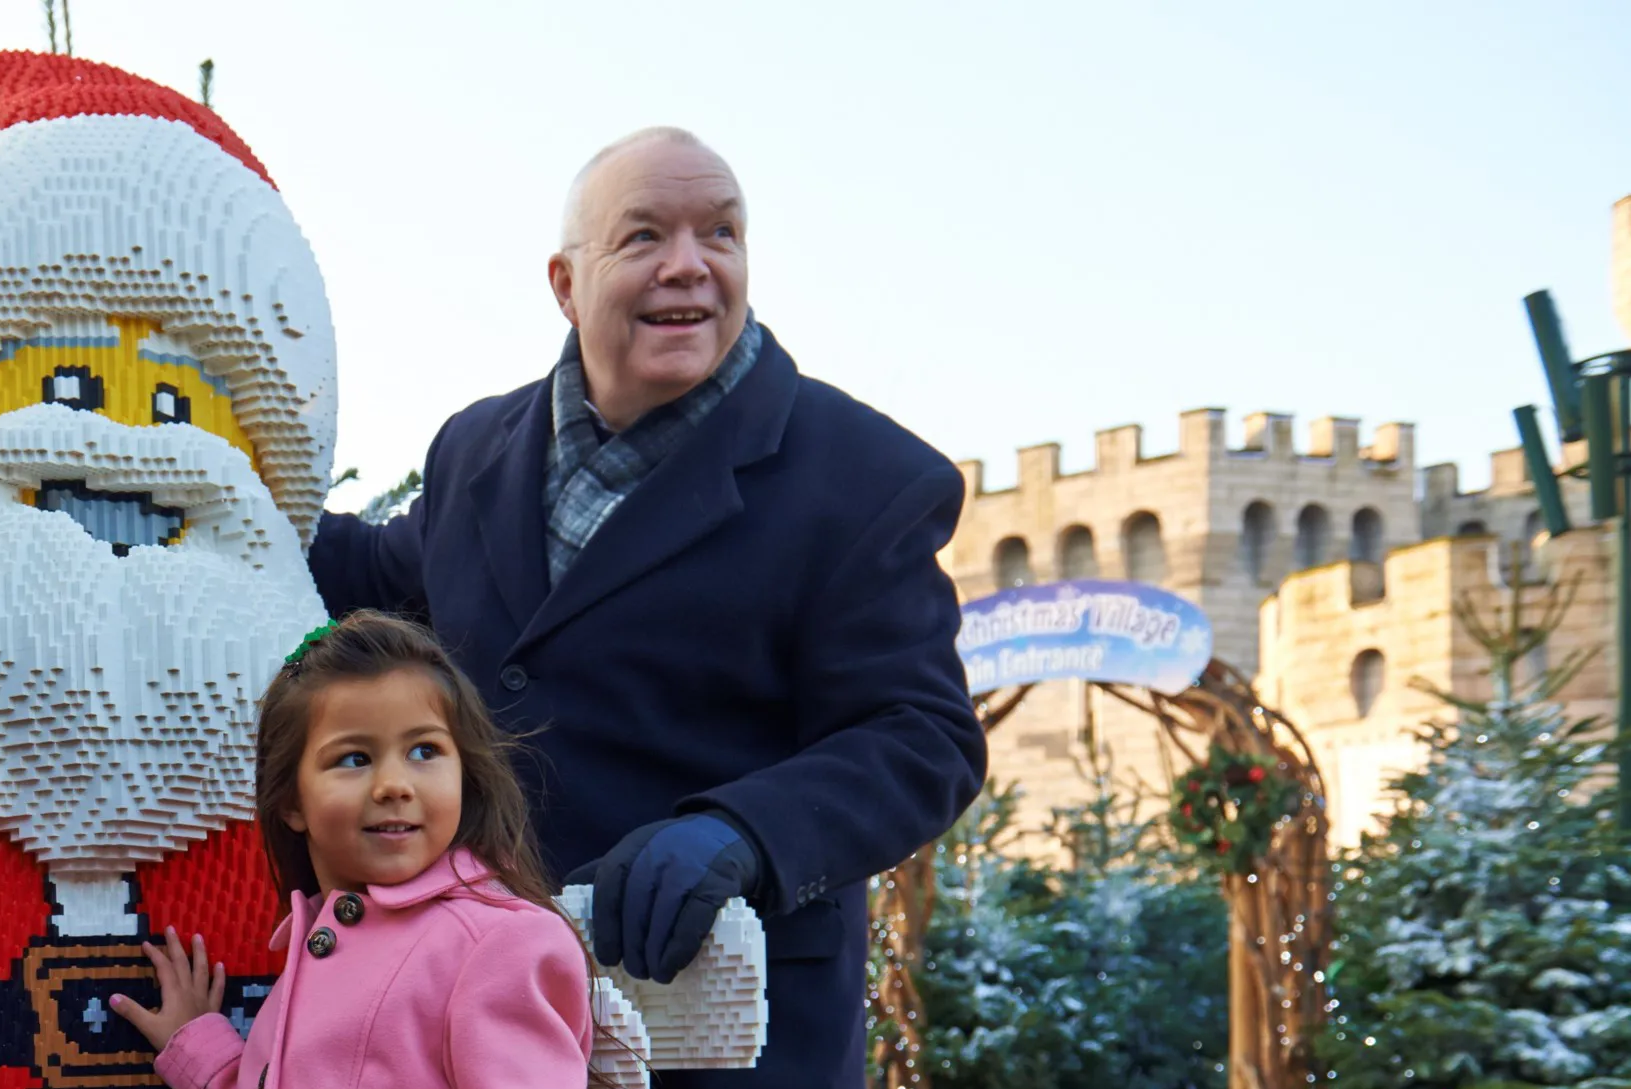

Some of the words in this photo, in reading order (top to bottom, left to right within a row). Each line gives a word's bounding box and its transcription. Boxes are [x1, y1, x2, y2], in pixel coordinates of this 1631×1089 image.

[959, 599, 1082, 649] Christmas
[1090, 595, 1180, 648] Village
[999, 646, 1103, 679] Entrance
